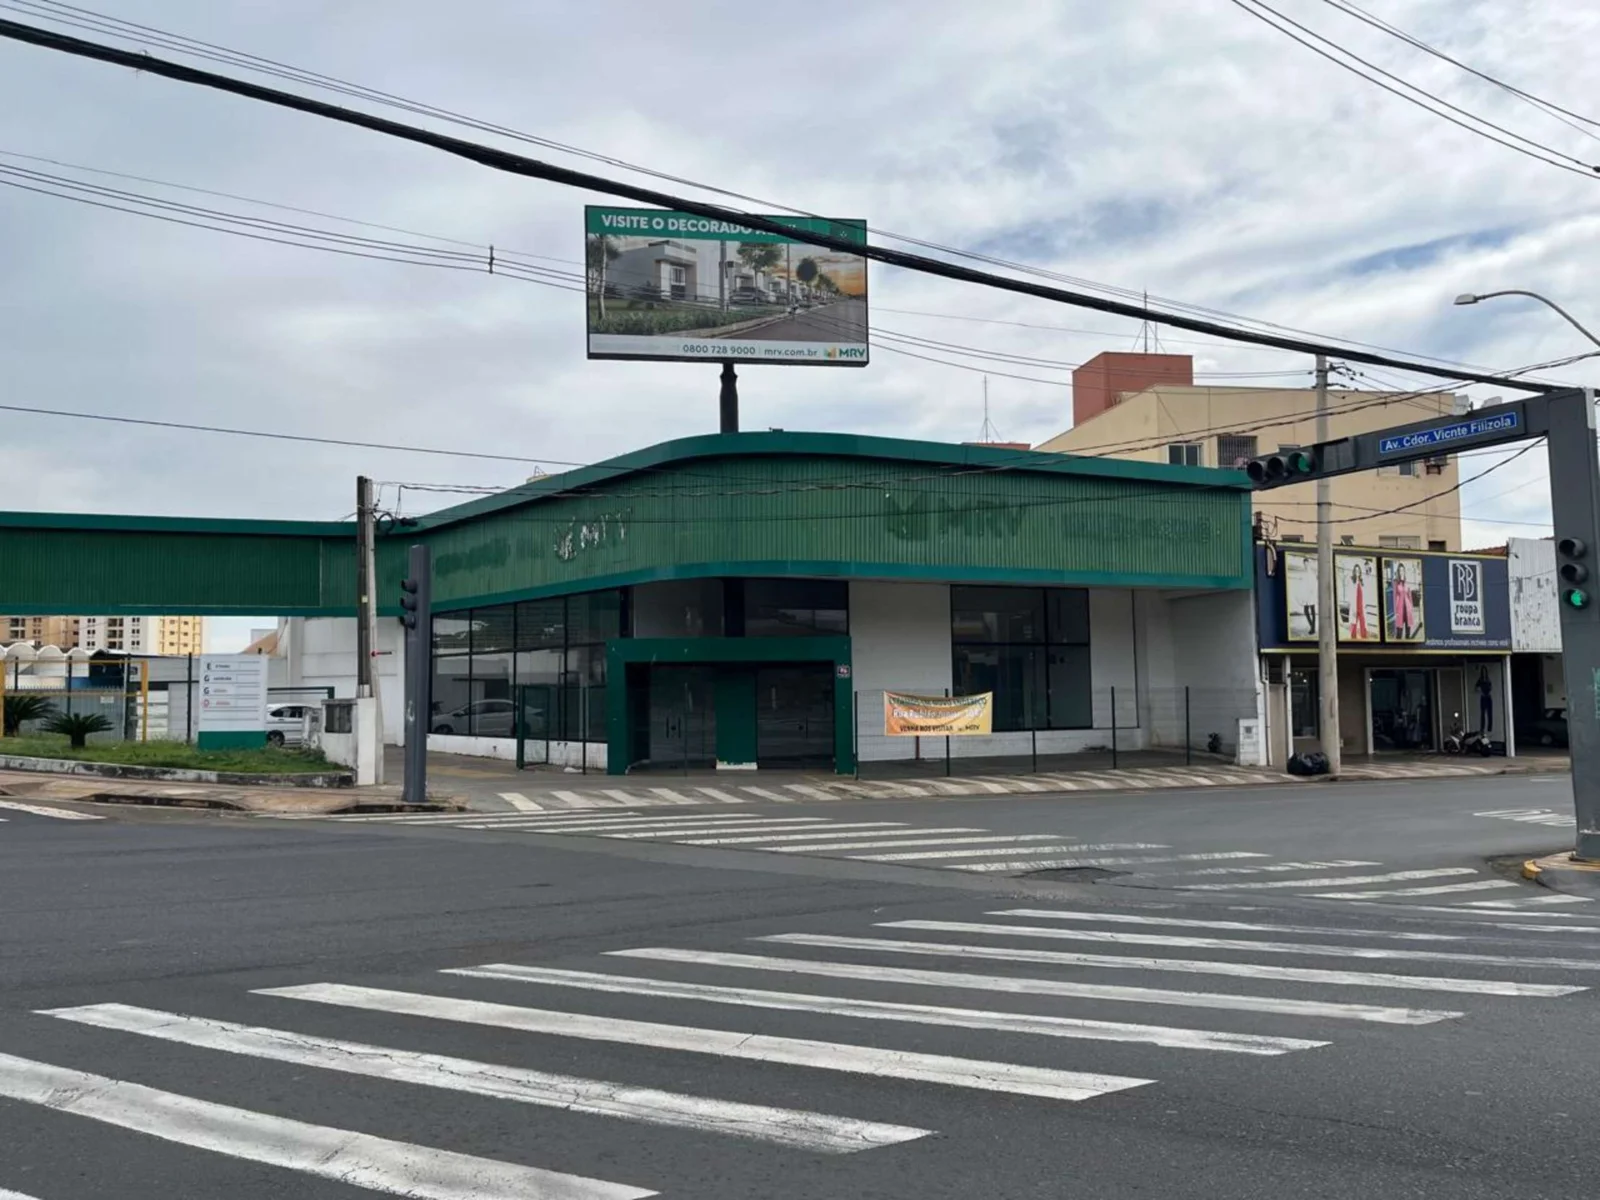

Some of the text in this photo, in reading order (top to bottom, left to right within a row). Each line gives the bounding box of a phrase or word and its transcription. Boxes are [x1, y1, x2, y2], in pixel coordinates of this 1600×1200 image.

[601, 214, 649, 229] VISITE
[652, 217, 664, 230] O
[667, 218, 751, 235] DECORADO
[682, 344, 756, 355] 0800 728 9000
[764, 348, 818, 357] mrv.com.br
[839, 348, 866, 358] MRV
[1385, 439, 1400, 450] Av.
[1403, 435, 1431, 446] Cdor.
[1470, 417, 1511, 433] Filizola
[1455, 604, 1478, 615] roupa
[1454, 612, 1481, 626] branca
